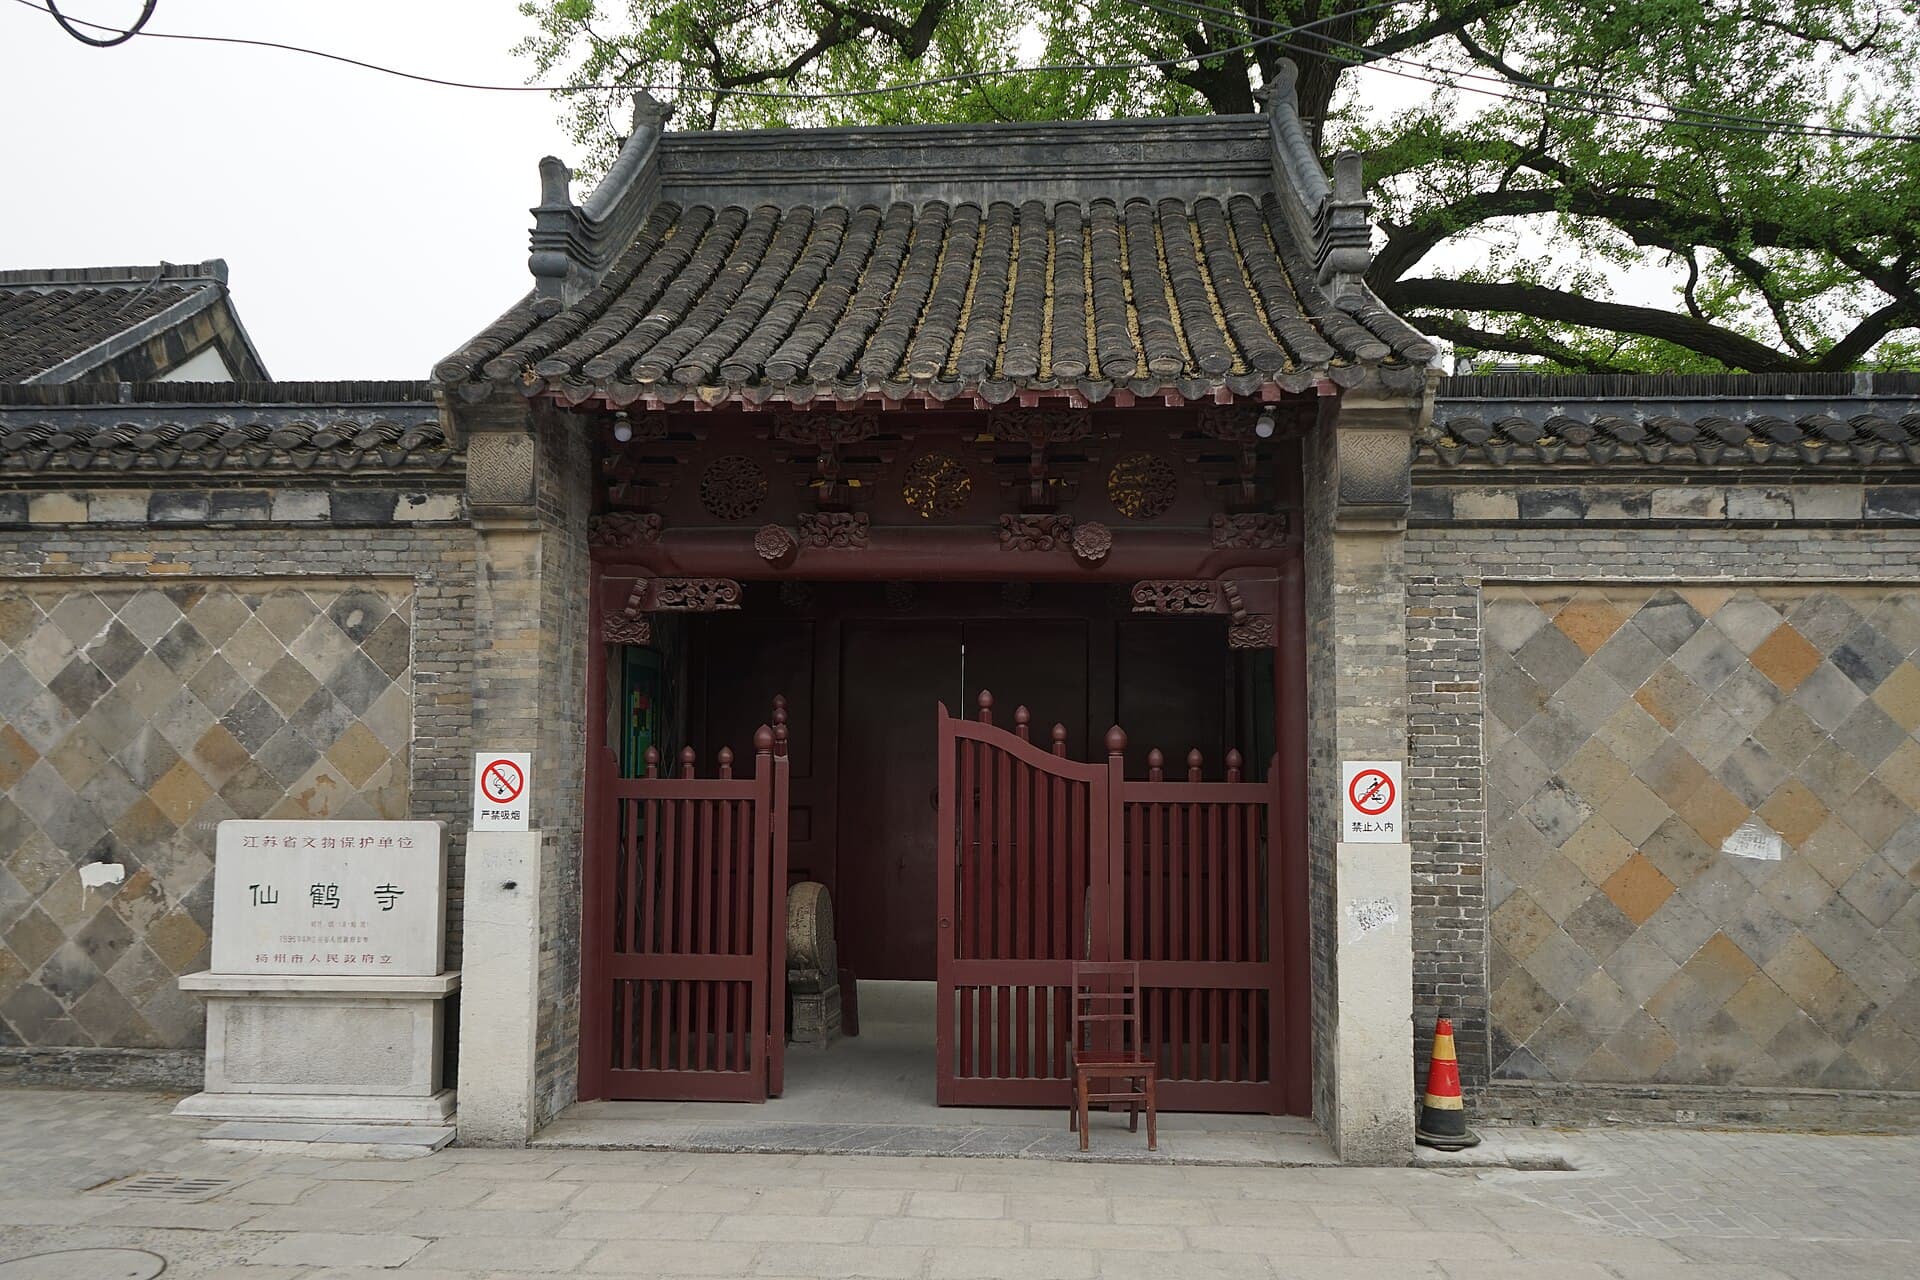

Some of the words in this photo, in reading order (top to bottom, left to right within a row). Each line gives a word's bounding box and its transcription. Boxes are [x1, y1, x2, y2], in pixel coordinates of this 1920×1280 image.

[1351, 822, 1394, 832] 禁止入内
[242, 835, 414, 849] 江苏省文物保护单位
[248, 882, 405, 911] 仙鹤寺
[255, 953, 393, 964] 扬州市人民政府立
